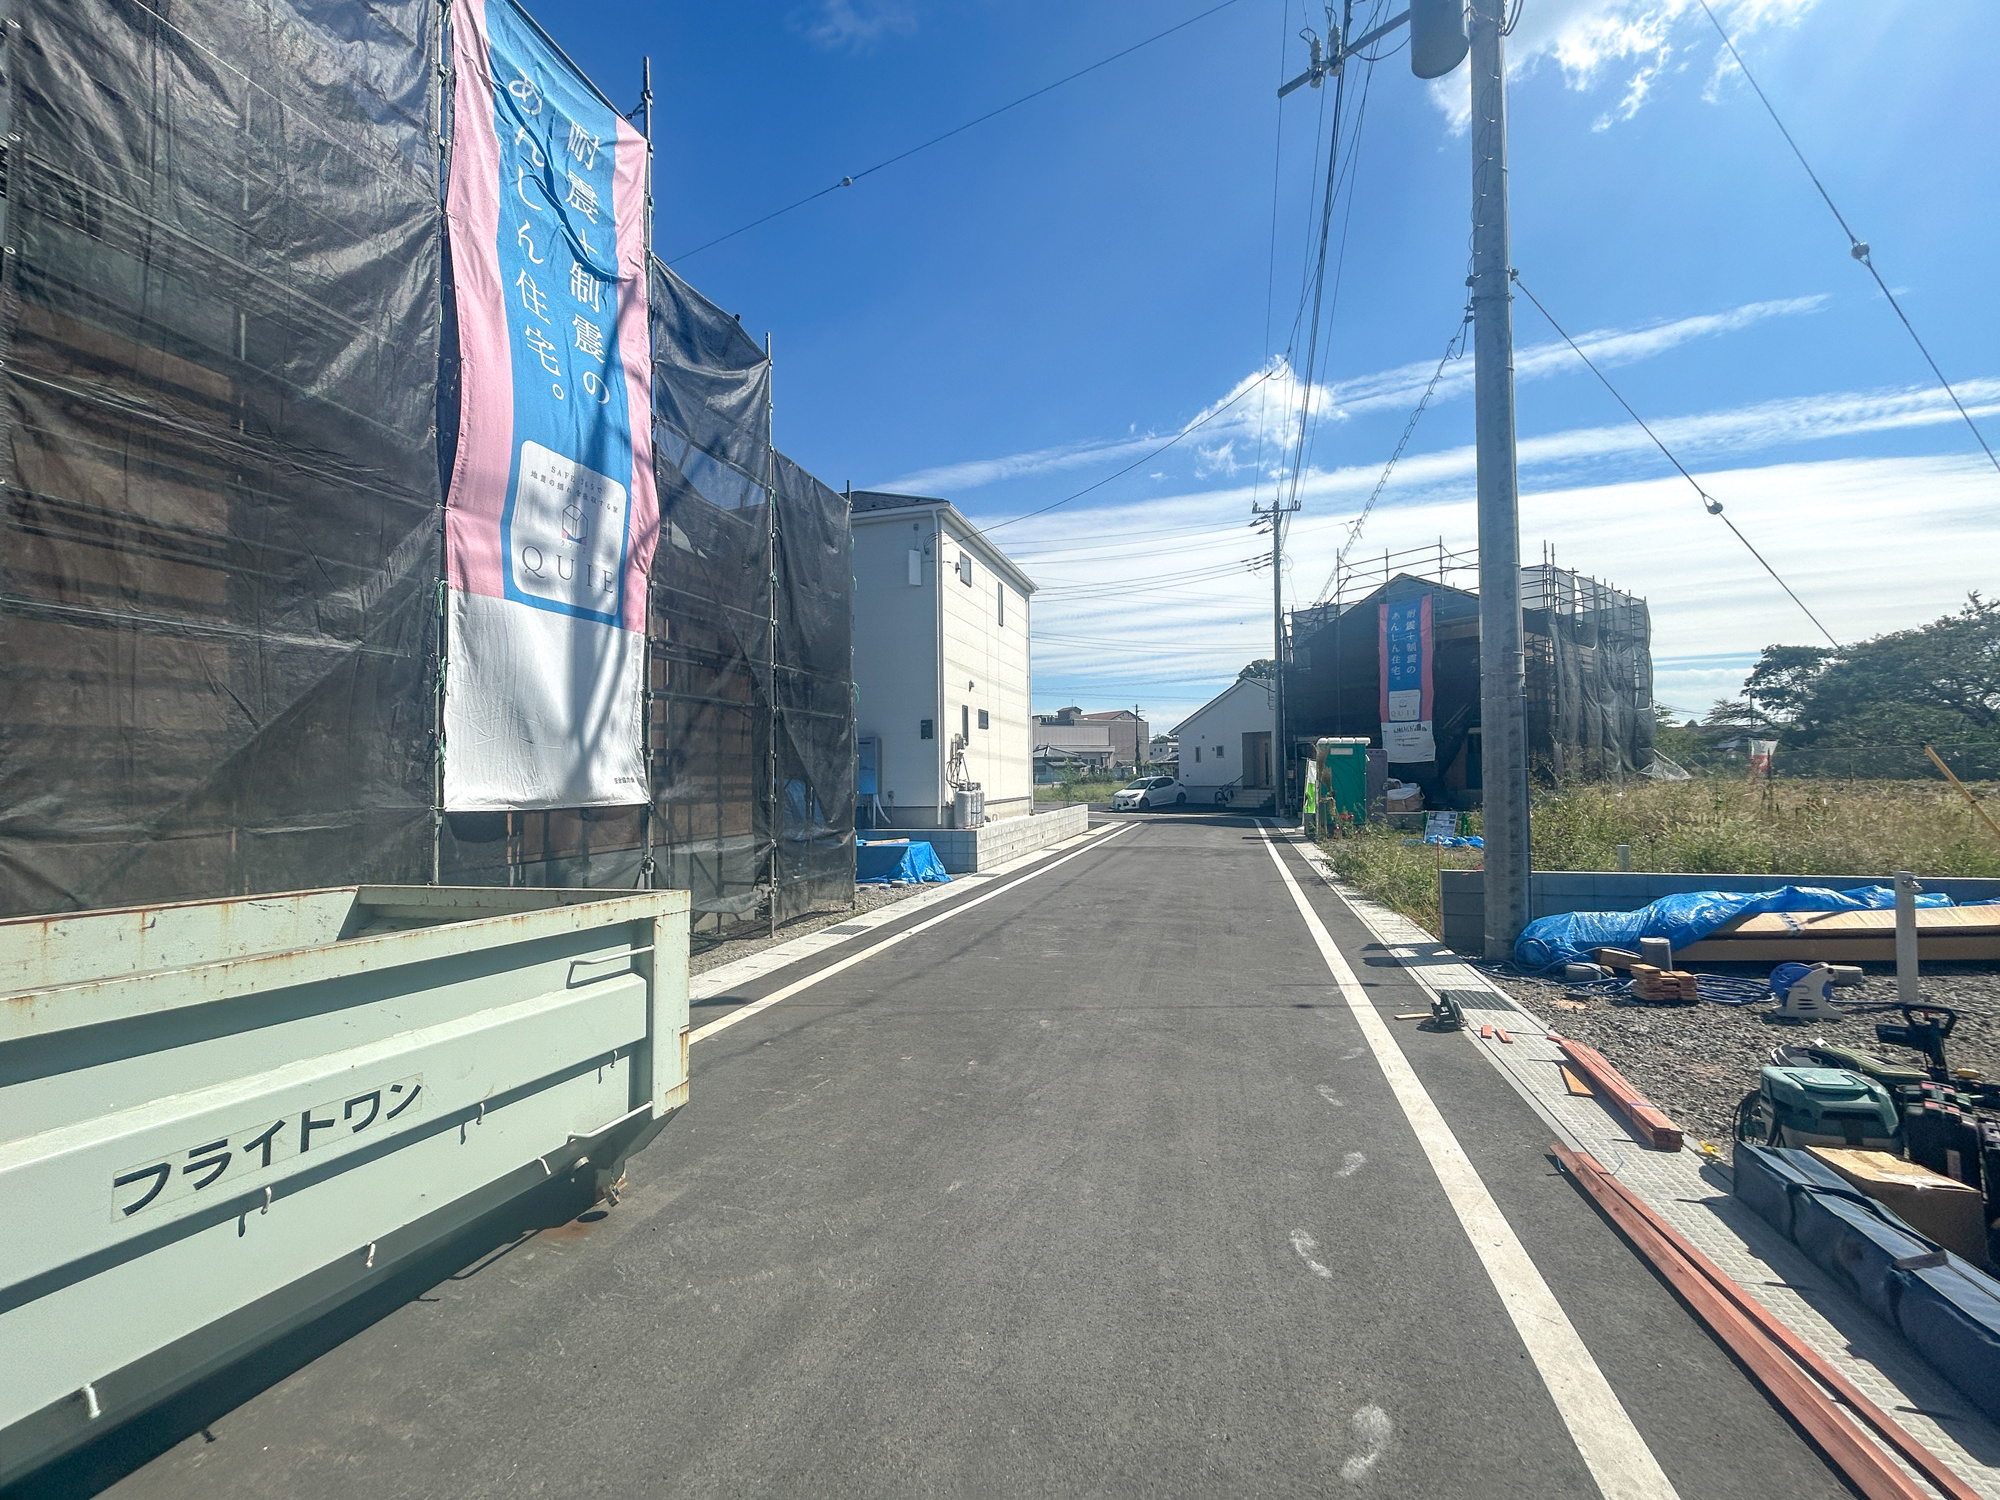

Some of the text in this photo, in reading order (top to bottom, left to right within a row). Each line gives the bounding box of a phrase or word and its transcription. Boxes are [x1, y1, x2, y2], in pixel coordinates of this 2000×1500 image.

[521, 545, 614, 594] QUIE
[113, 1083, 423, 1217] フライトワン
